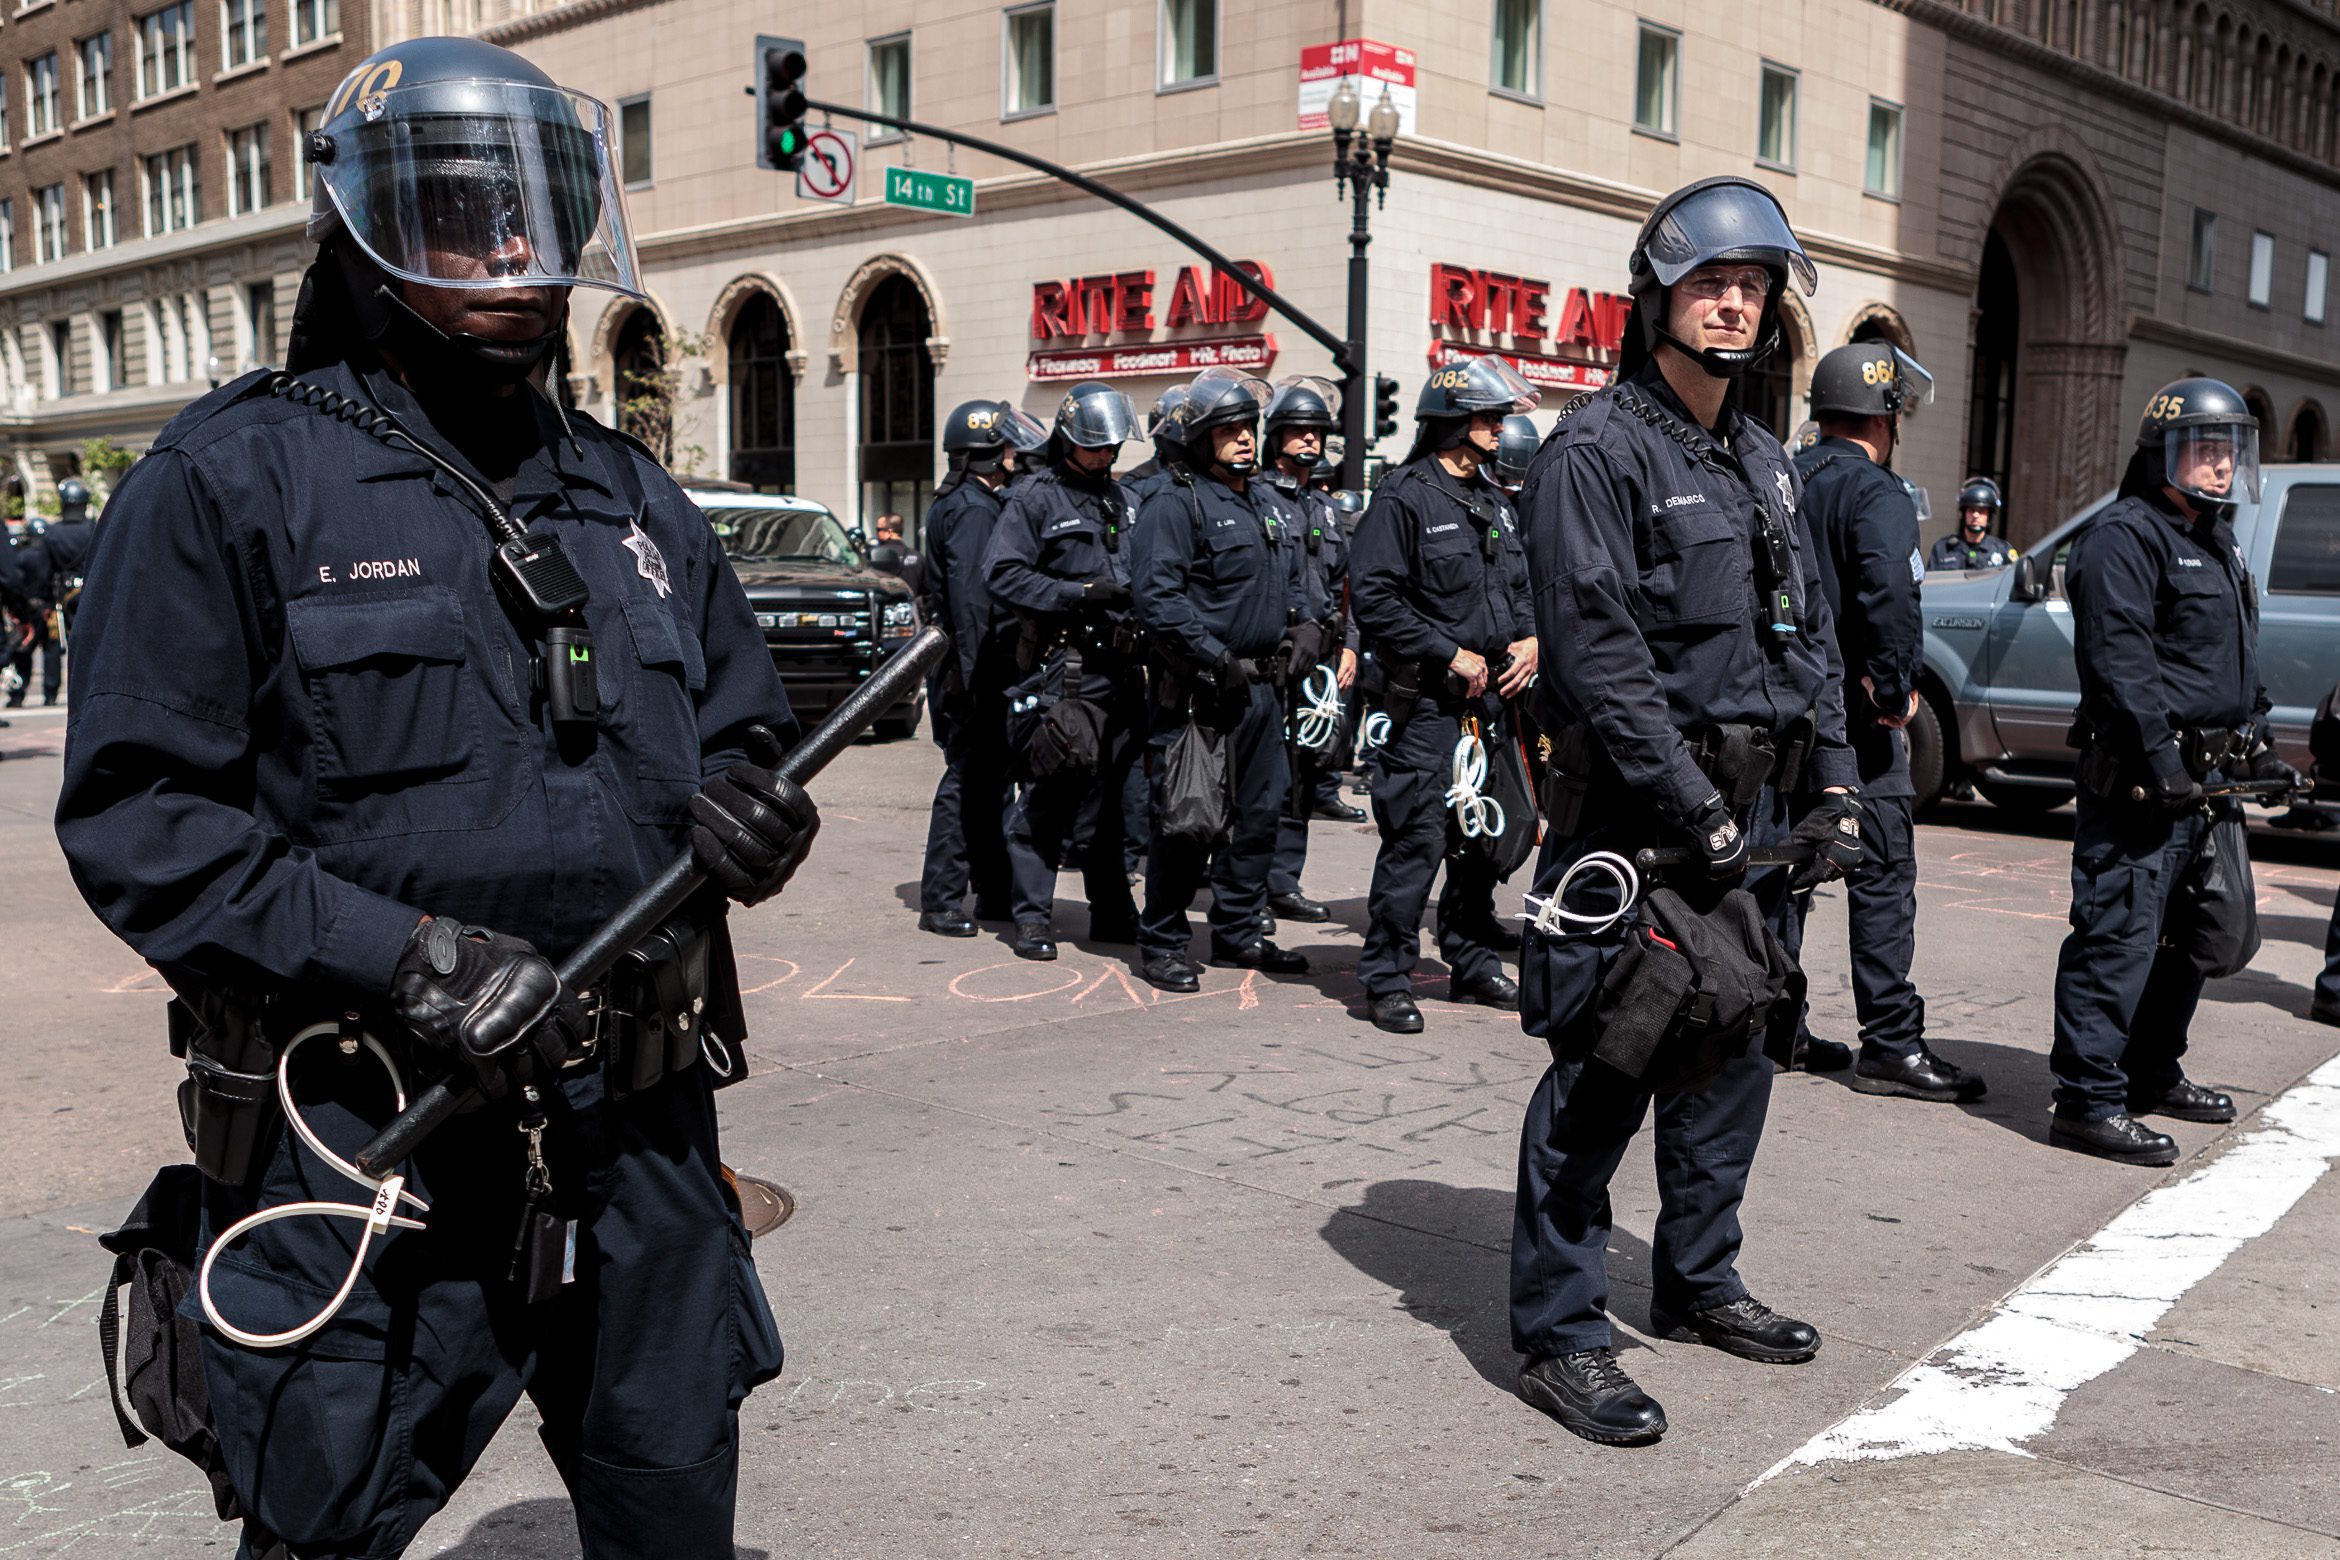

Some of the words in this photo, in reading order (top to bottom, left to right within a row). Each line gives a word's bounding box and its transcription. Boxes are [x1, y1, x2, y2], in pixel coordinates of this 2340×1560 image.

[895, 176, 933, 201] 14th
[946, 184, 965, 206] St
[1033, 270, 1155, 339] RITE
[1165, 259, 1275, 328] AID
[1431, 262, 1550, 339] RITE
[1039, 357, 1101, 374] Pharmacy
[1112, 350, 1178, 370] Foodmart
[1220, 345, 1262, 362] Photo
[1517, 358, 1576, 382] Foodmart
[1431, 370, 1469, 390] 082
[2143, 394, 2185, 420] 835
[1651, 504, 1662, 514] R.
[1665, 493, 1706, 508] DEMARCO
[319, 565, 337, 583] E.
[349, 557, 421, 580] JORDAN
